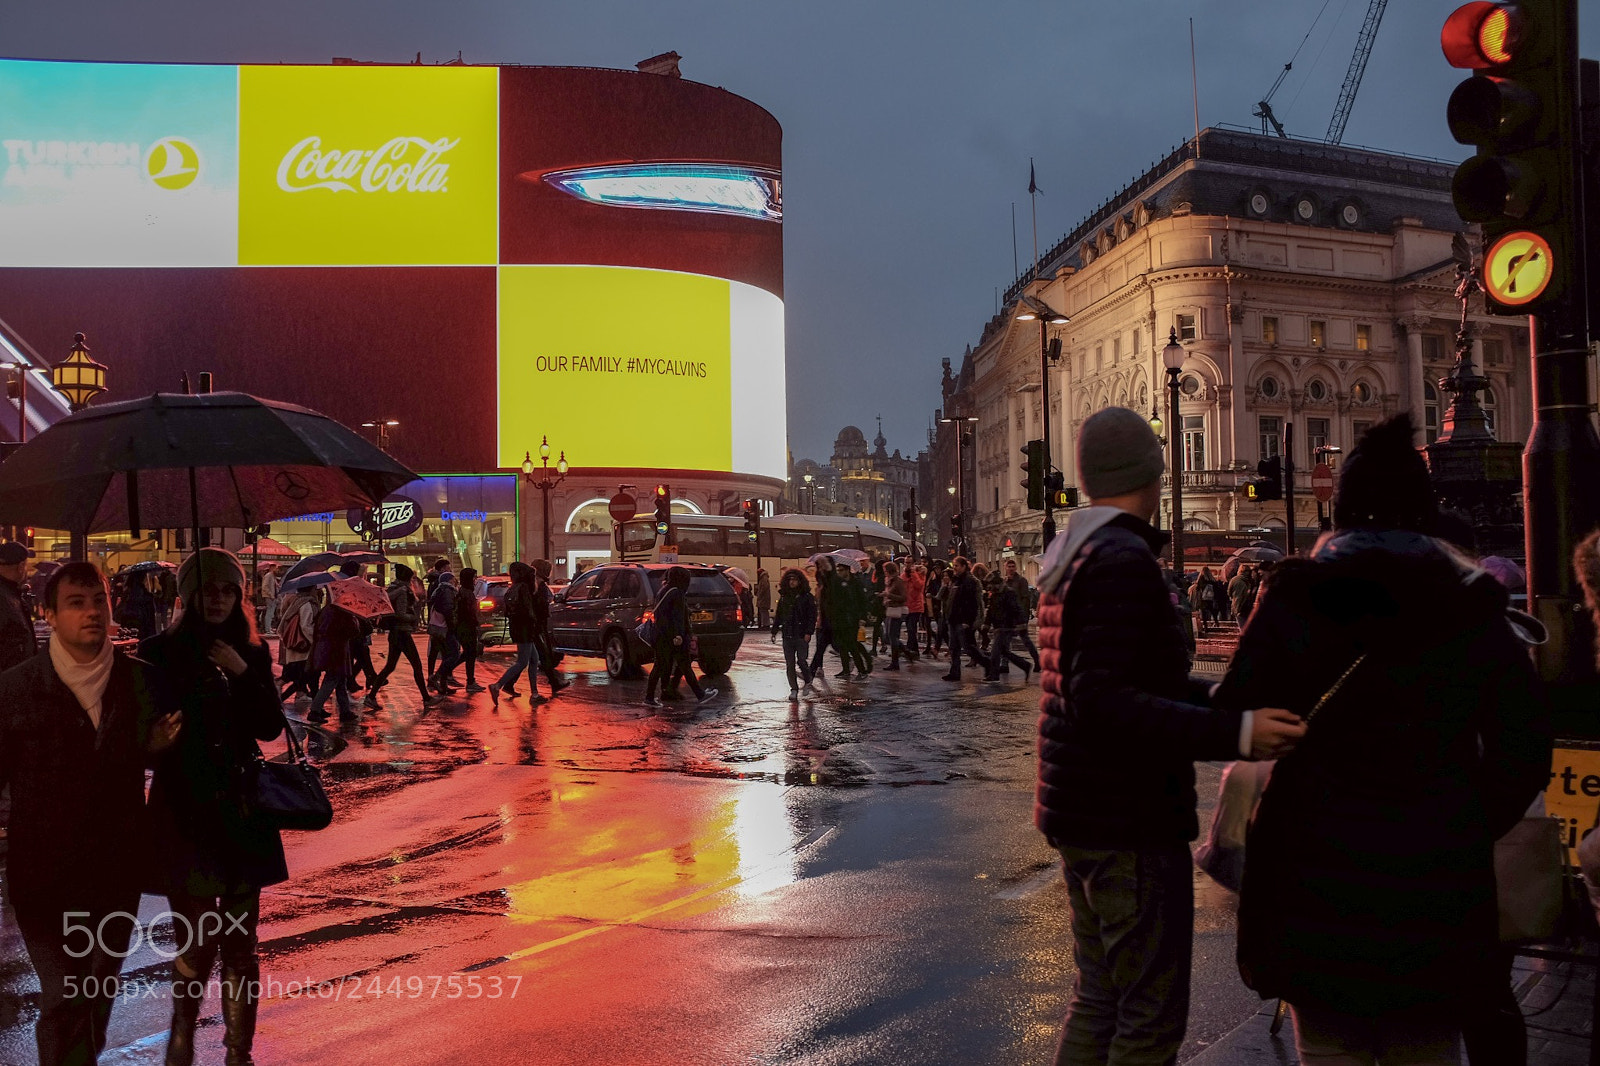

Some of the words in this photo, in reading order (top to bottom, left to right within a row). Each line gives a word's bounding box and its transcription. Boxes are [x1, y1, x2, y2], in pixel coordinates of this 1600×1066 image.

[276, 136, 461, 193] Coca-Cola
[536, 356, 568, 372] OUR
[572, 356, 623, 373] FAMILY.
[627, 357, 707, 378] #MYCALVINS
[353, 501, 414, 532] oots
[441, 509, 488, 523] beauty
